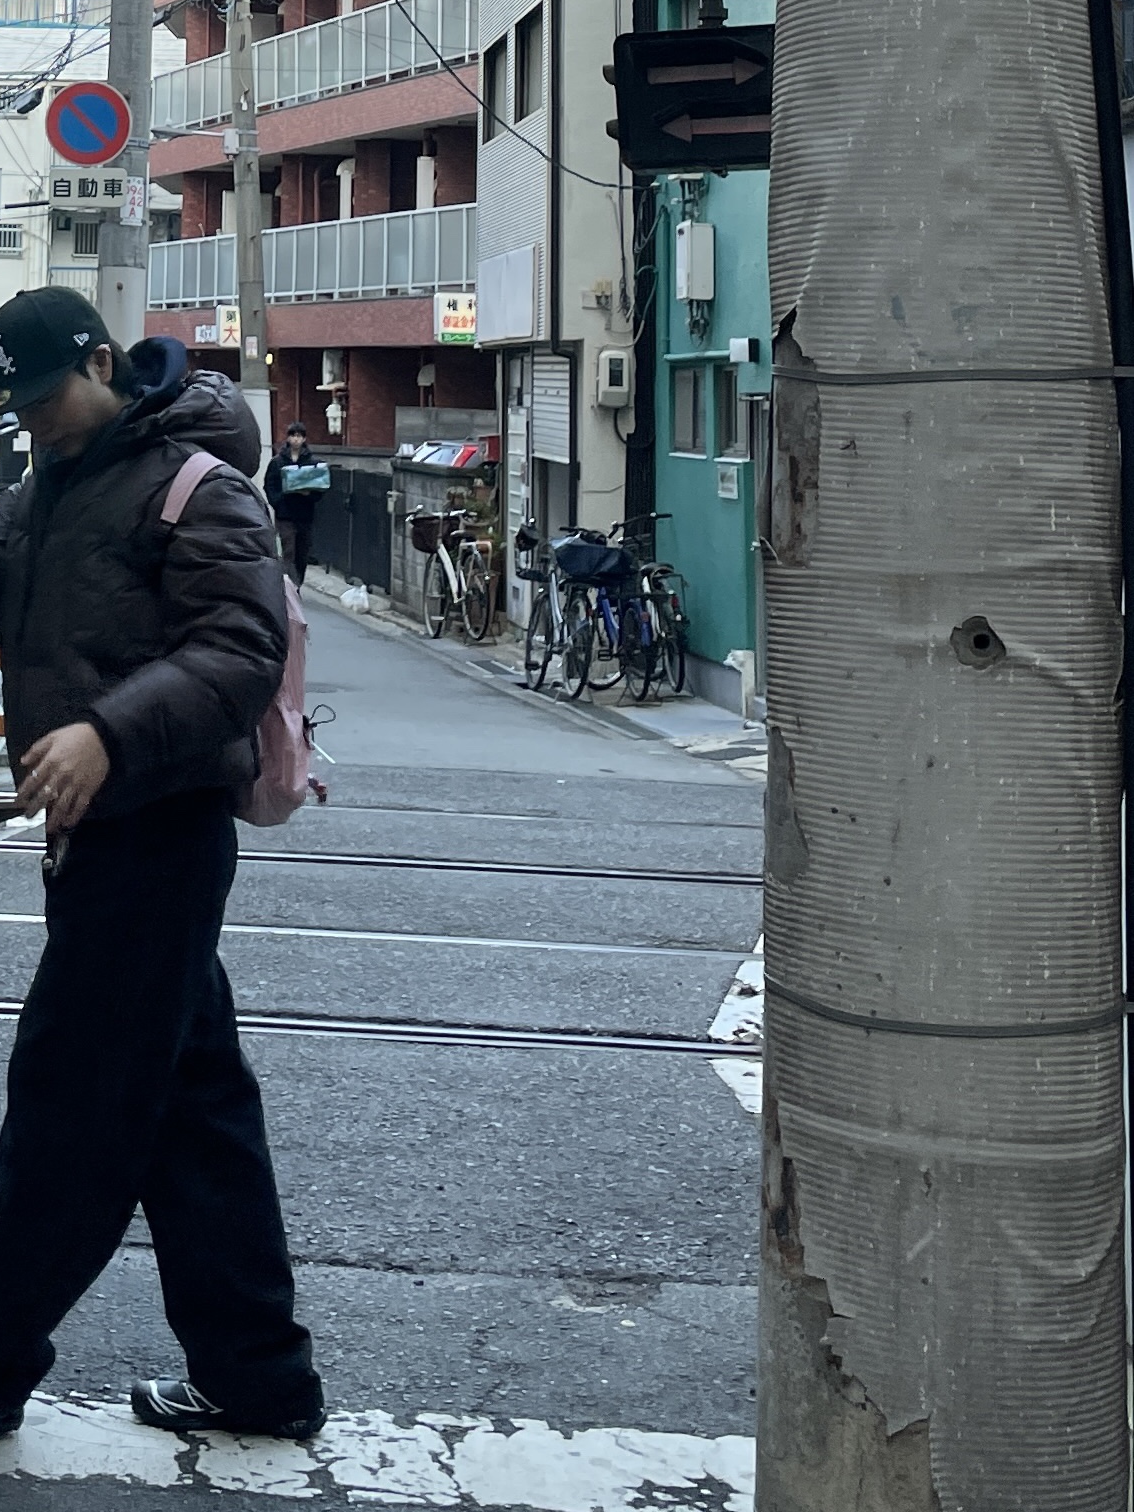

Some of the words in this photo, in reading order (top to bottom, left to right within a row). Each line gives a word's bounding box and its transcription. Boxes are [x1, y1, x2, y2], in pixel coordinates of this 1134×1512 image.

[53, 178, 123, 199] 自動車
[128, 207, 136, 217] A
